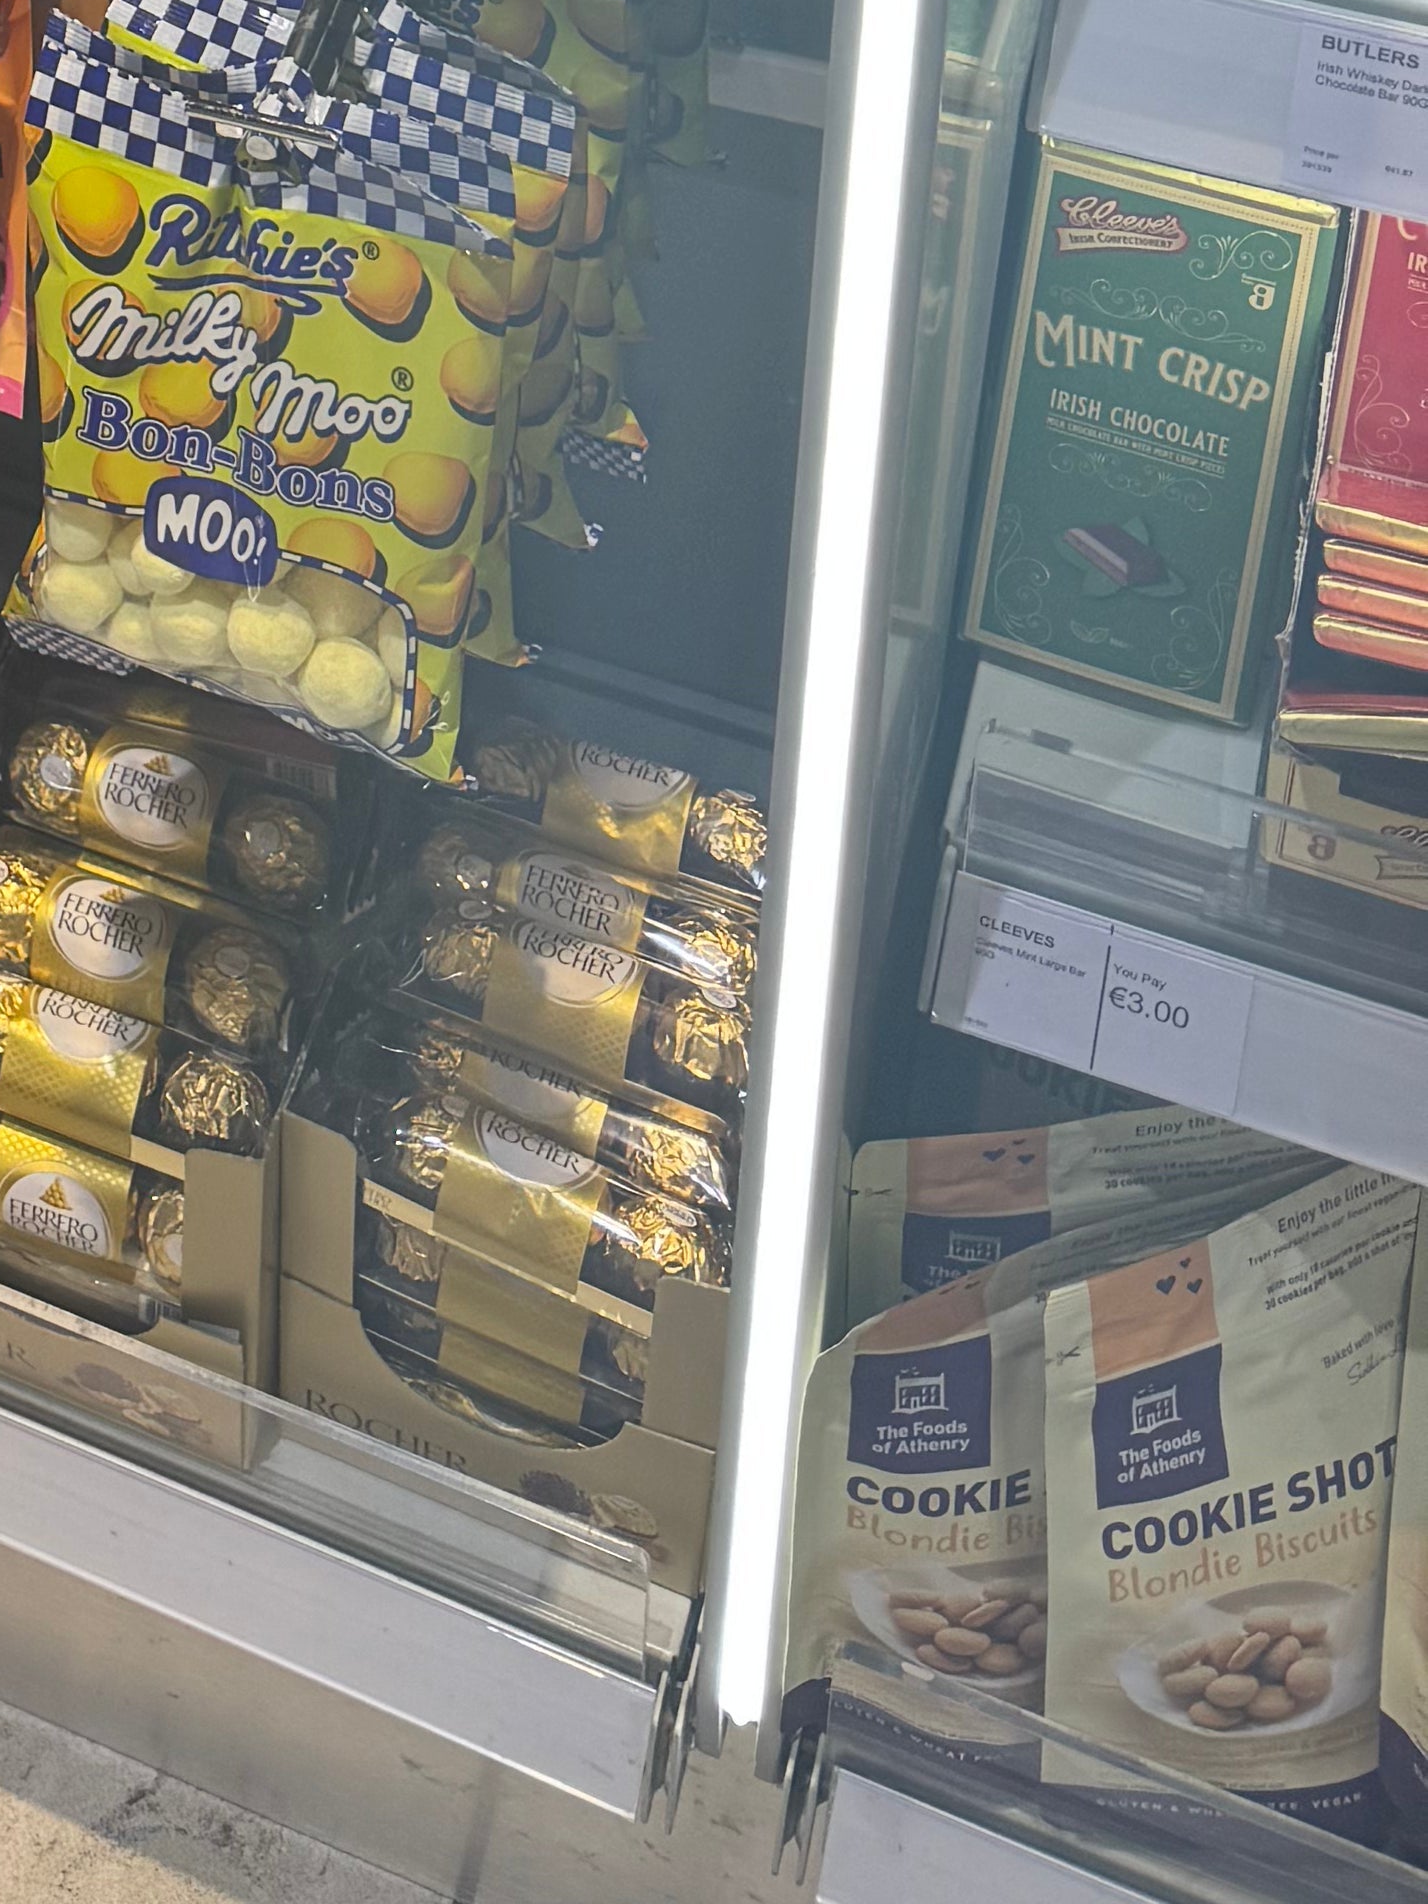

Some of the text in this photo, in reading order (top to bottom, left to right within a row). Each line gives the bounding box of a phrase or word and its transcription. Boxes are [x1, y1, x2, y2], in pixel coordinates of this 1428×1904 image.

[1321, 34, 1420, 69] BUTLERS
[1315, 74, 1375, 97] Chocolate
[1378, 89, 1399, 103] Bar
[1317, 60, 1399, 90] Irish Whiskey
[1061, 196, 1180, 237] Cleeve's
[1034, 310, 1271, 411] MINT CRISP
[1049, 388, 1102, 422] IRISH
[1110, 406, 1230, 457] CHOCOLATE
[77, 388, 397, 521] Bon-Bons
[979, 915, 1055, 948] CLEEVES
[1112, 963, 1167, 992] You Pay
[1109, 986, 1190, 1030] €3.00
[1277, 1178, 1378, 1234] Enjoy the little
[302, 1388, 467, 1474] ROCHER
[871, 1434, 970, 1457] of Athenry
[877, 1419, 968, 1439] The Foods
[1118, 1429, 1202, 1467] The Foods
[1117, 1446, 1206, 1485] of Athenry
[846, 1469, 1032, 1518] COOKIE
[847, 1506, 991, 1555] Blondie
[1101, 1484, 1276, 1562] COOKIE
[1108, 1505, 1379, 1603] Blondie Biscuits
